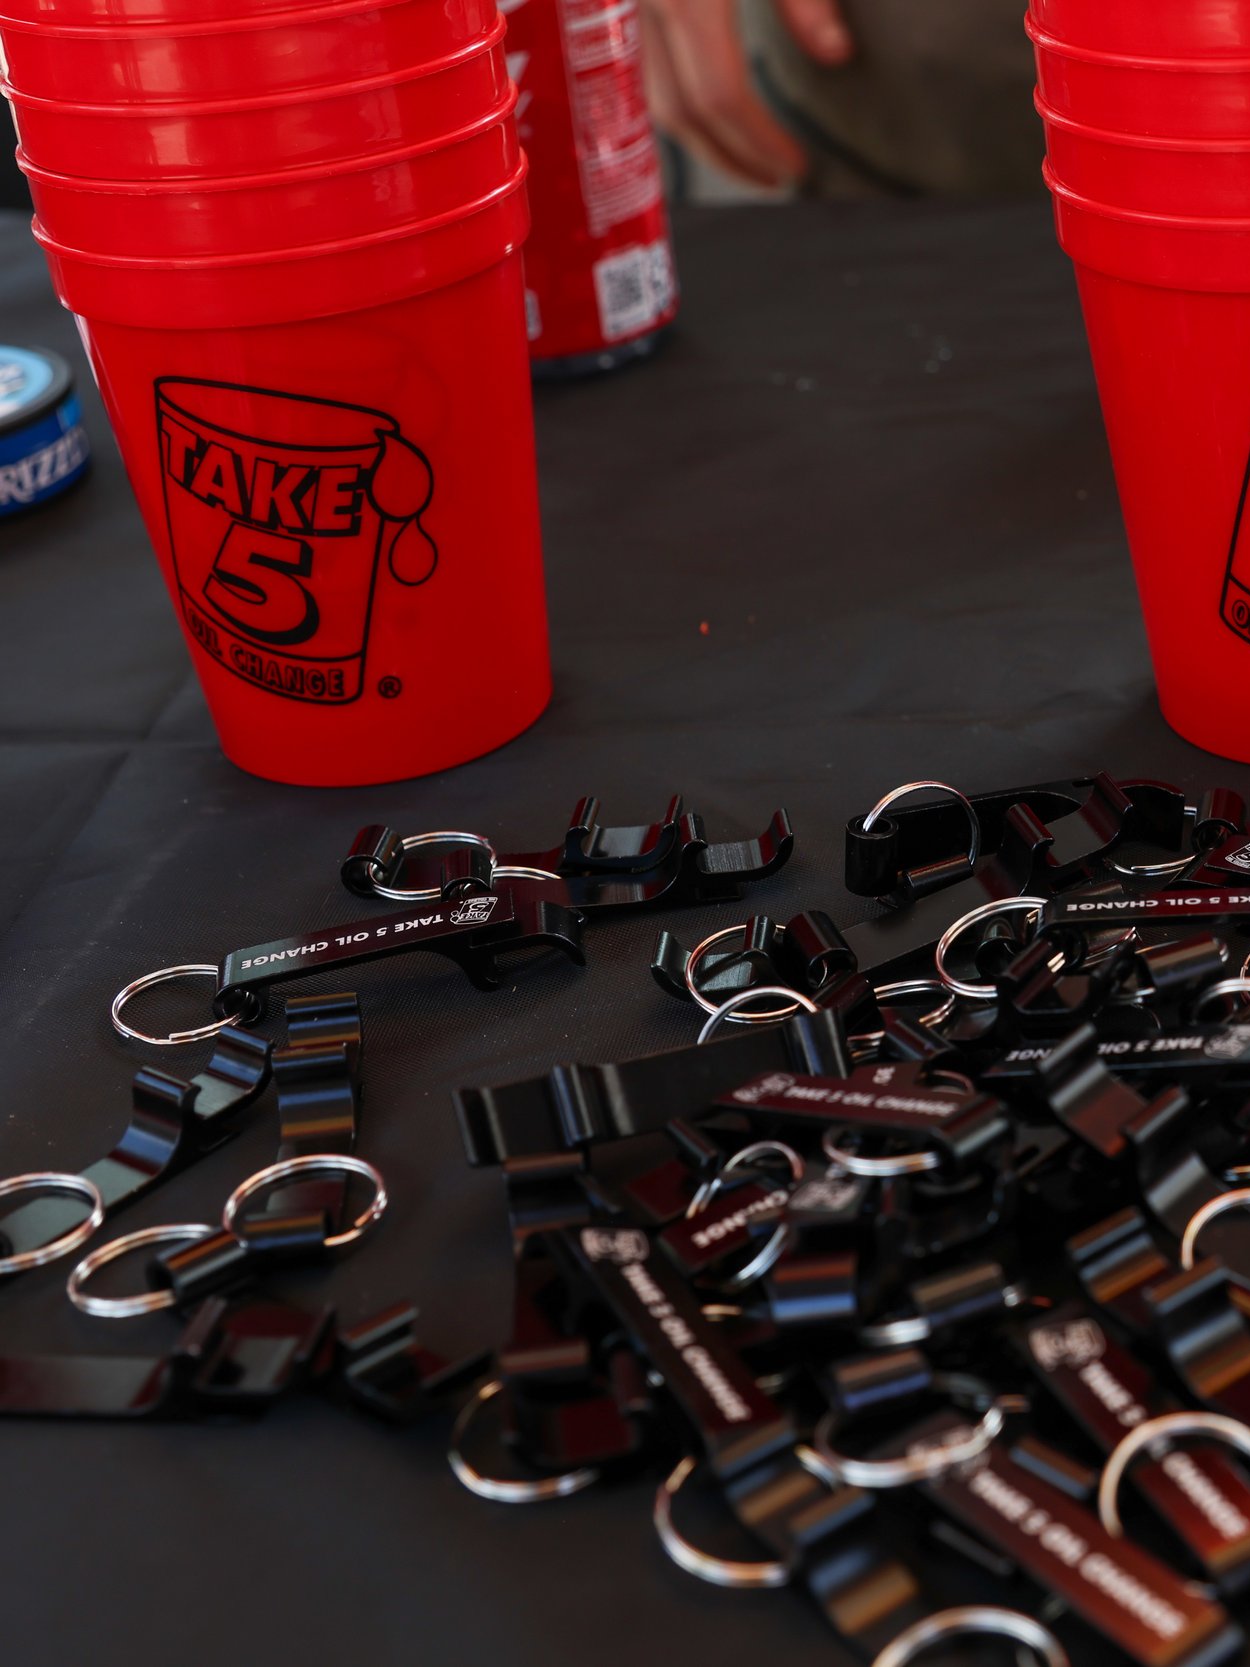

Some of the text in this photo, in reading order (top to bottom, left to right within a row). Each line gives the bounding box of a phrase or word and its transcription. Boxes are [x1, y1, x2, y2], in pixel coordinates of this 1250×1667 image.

[158, 409, 369, 537] TAKE
[203, 519, 319, 646] 5
[229, 643, 346, 698] CHANGE
[1066, 899, 1159, 912] CHANGE
[1166, 897, 1201, 906] OIL
[1209, 896, 1220, 904] 5
[240, 913, 444, 970] TAKE 5 OIL CHANGE
[1098, 1040, 1130, 1055] OIL
[1151, 1036, 1204, 1051] TAKE
